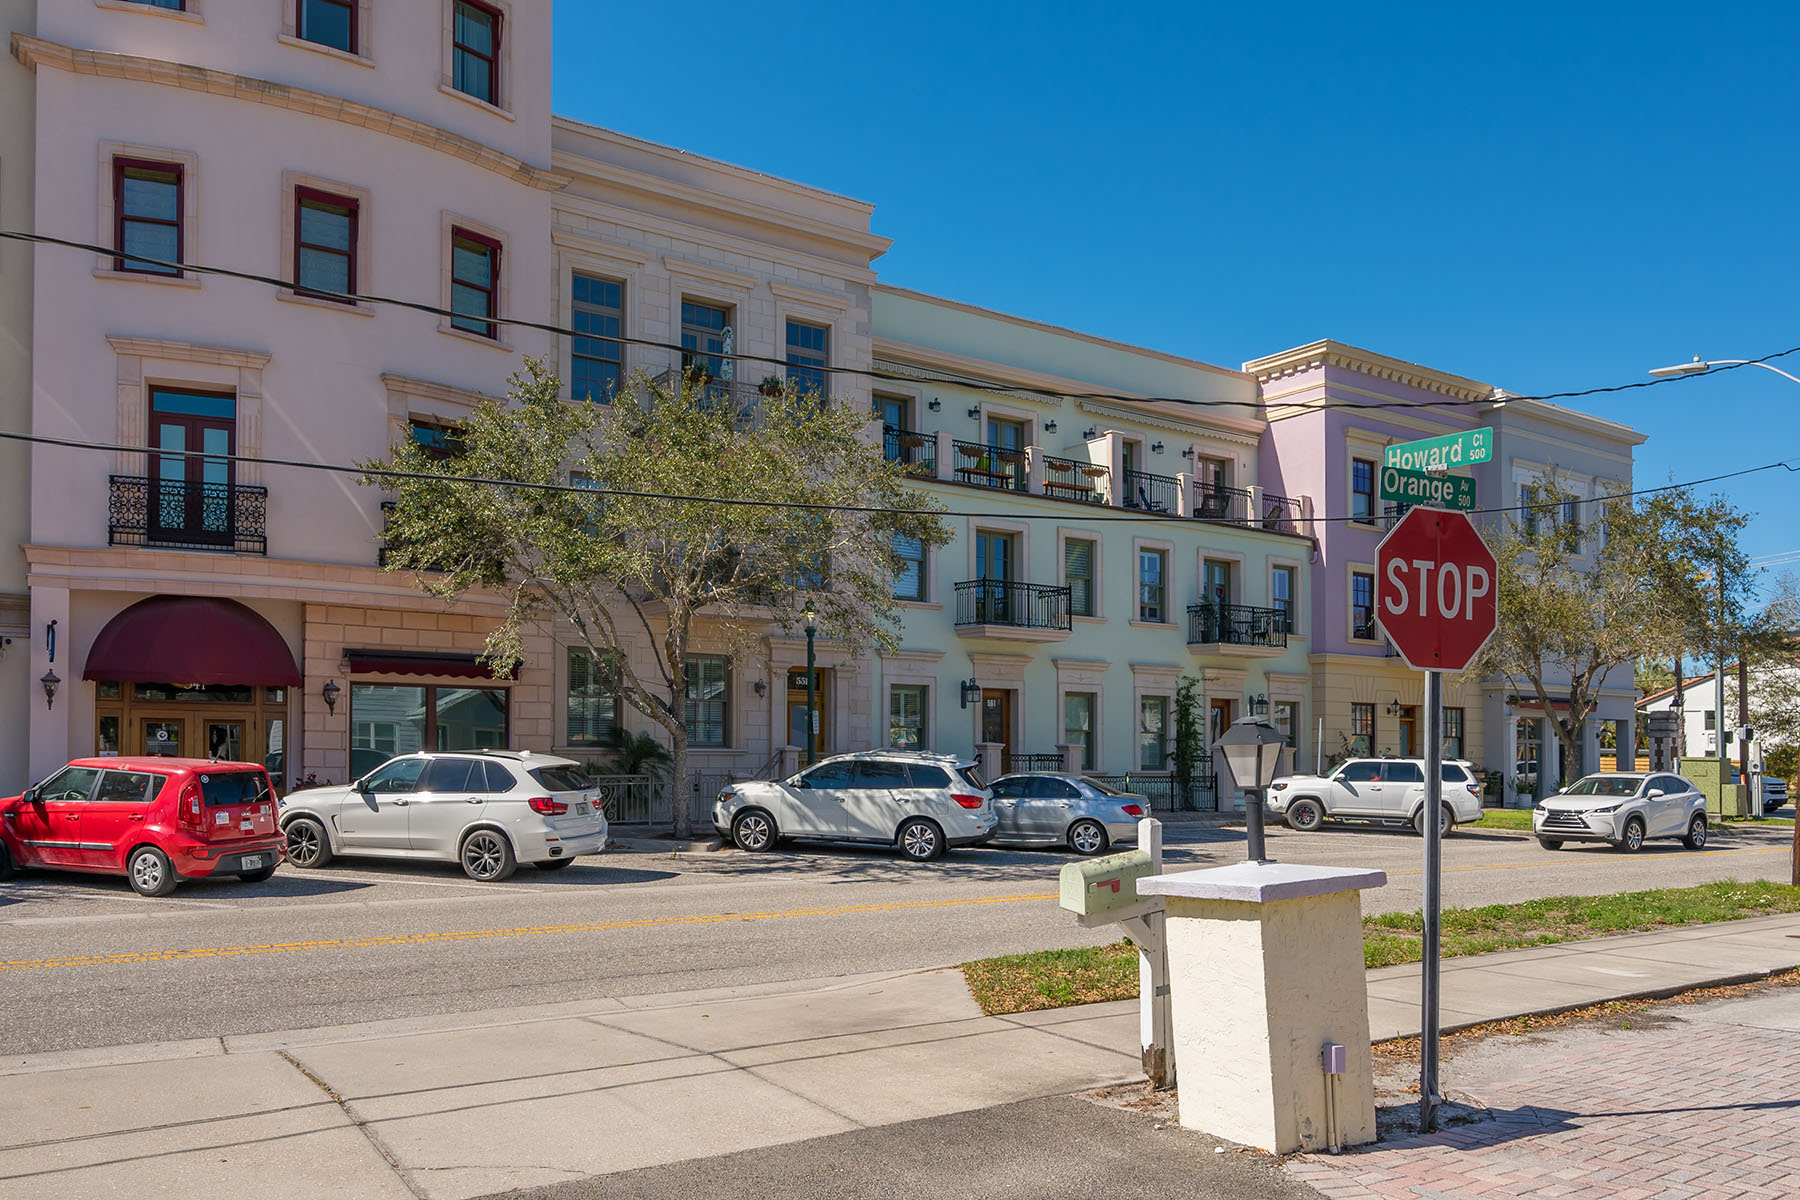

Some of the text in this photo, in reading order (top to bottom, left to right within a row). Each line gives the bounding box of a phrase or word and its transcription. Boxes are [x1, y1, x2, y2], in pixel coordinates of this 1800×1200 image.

[1388, 433, 1483, 470] Howard Ct
[1469, 447, 1486, 461] 500
[1383, 468, 1470, 501] Orange Av
[1458, 494, 1471, 507] 500
[1385, 557, 1489, 620] STOP
